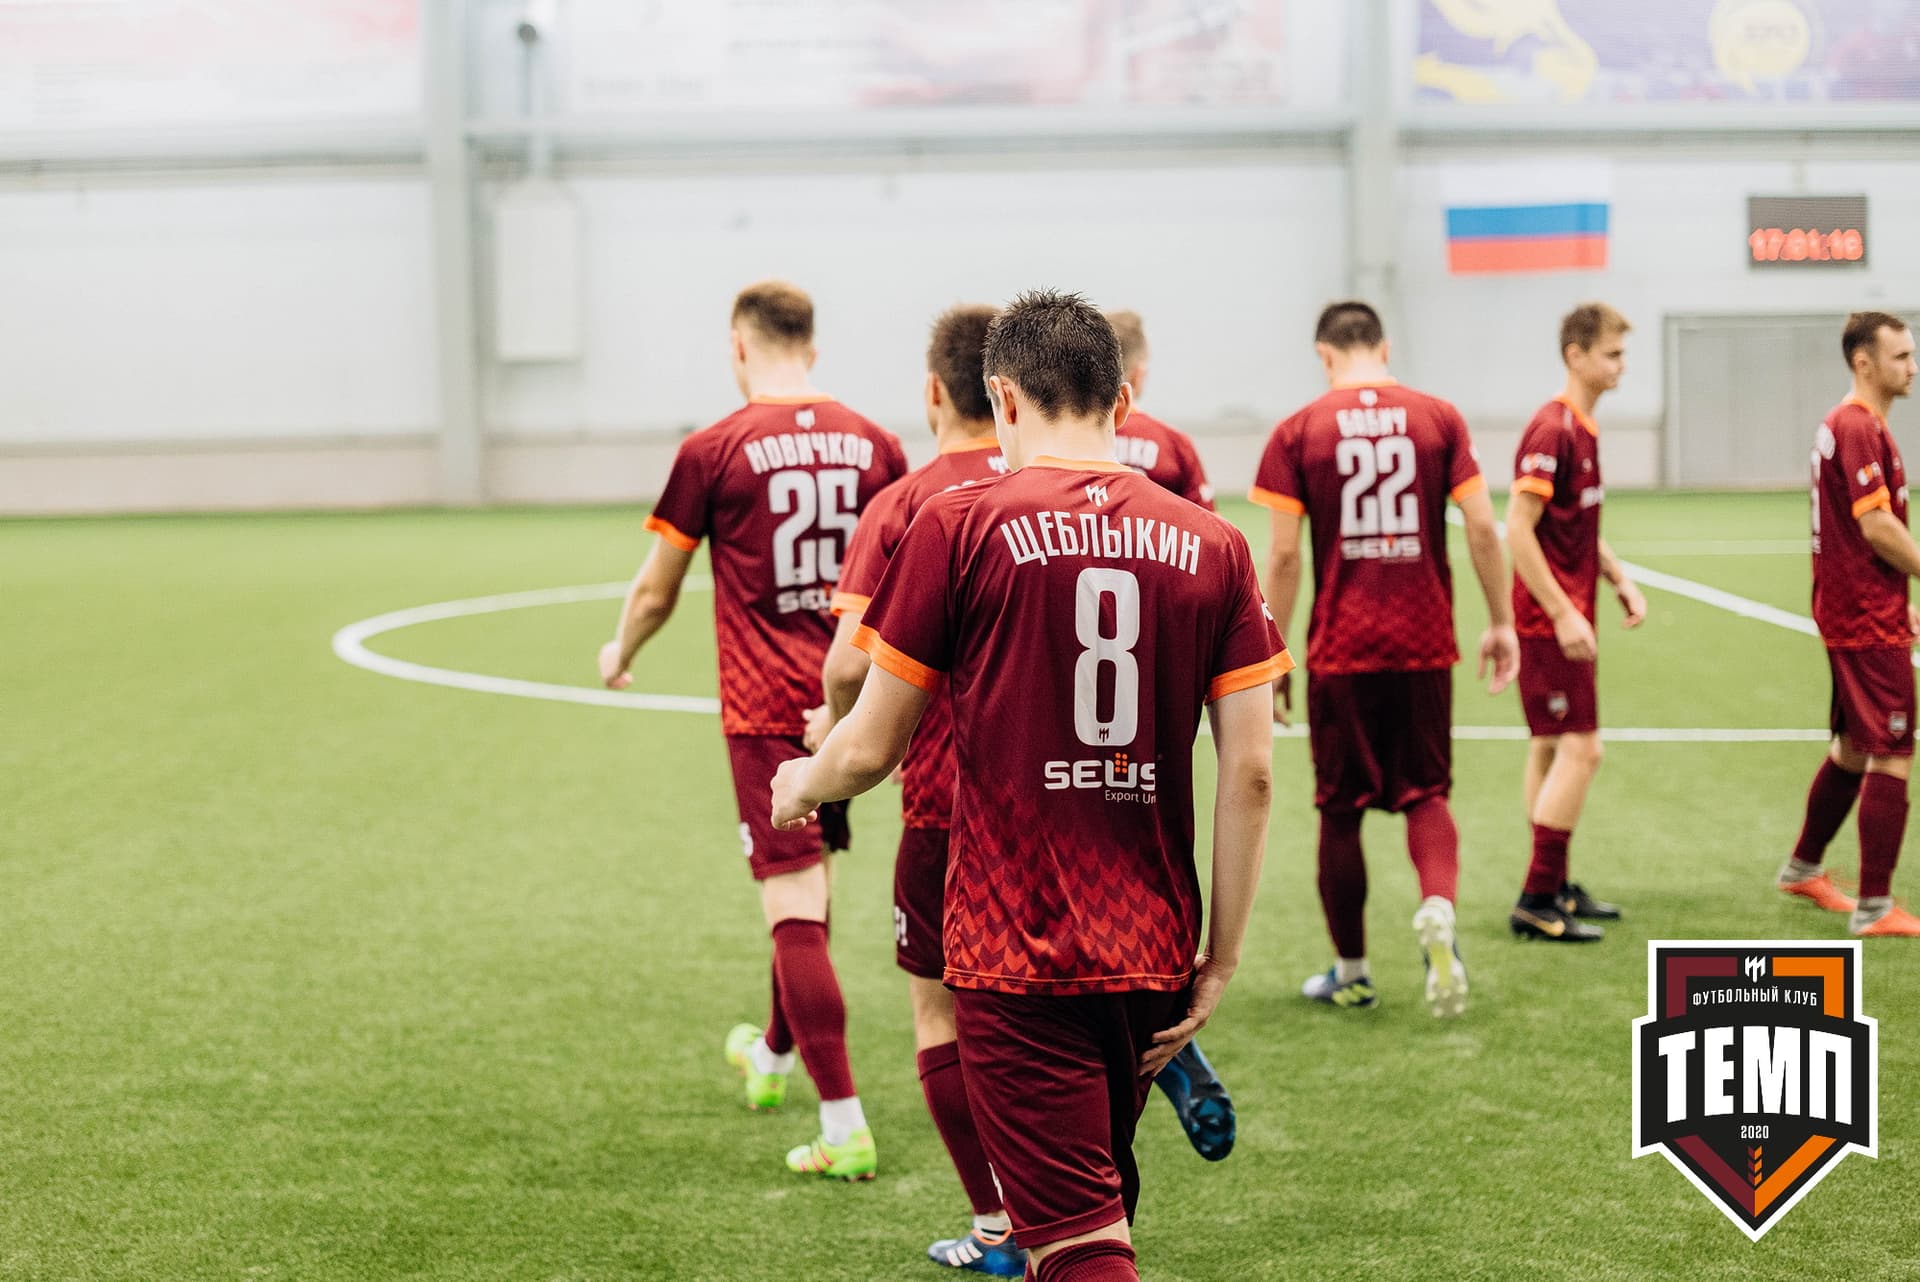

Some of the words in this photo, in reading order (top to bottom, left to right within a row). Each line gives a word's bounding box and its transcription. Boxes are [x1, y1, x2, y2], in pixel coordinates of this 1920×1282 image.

[744, 431, 874, 475] НОВИЧКОВ
[1335, 435, 1420, 538] 22
[768, 468, 860, 589] 25
[1000, 511, 1201, 576] ЩЕБЛЫКИН
[776, 587, 835, 614] SEU
[1074, 567, 1140, 746] 8
[1104, 789, 1140, 803] Export
